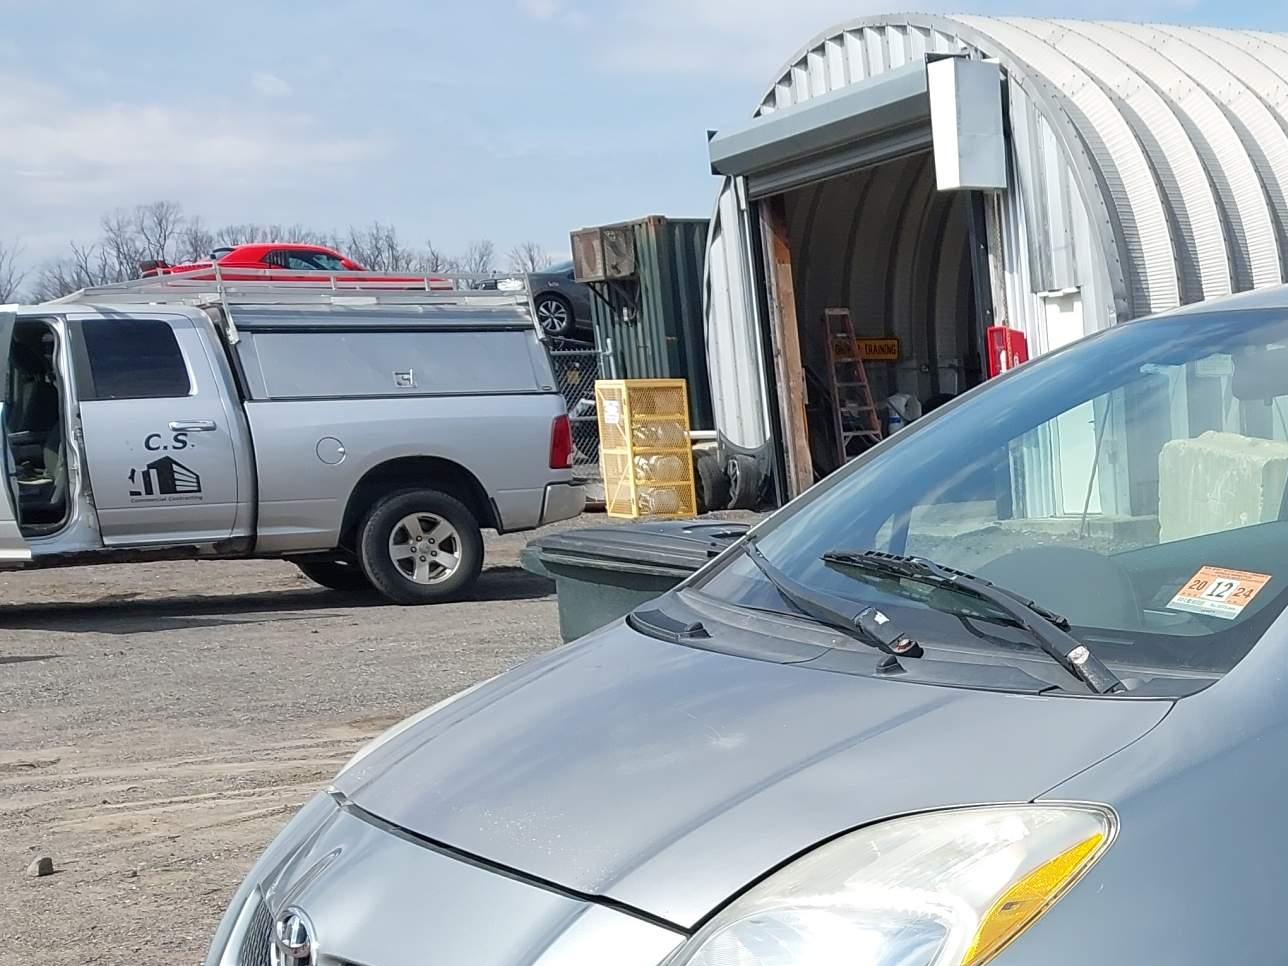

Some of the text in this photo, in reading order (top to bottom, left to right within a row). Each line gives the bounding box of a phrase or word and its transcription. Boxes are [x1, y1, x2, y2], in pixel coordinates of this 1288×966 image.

[865, 343, 897, 356] TRAINING
[144, 432, 195, 451] C.S.
[168, 495, 203, 503] Contracting
[1188, 579, 1254, 599] 20 12 24
